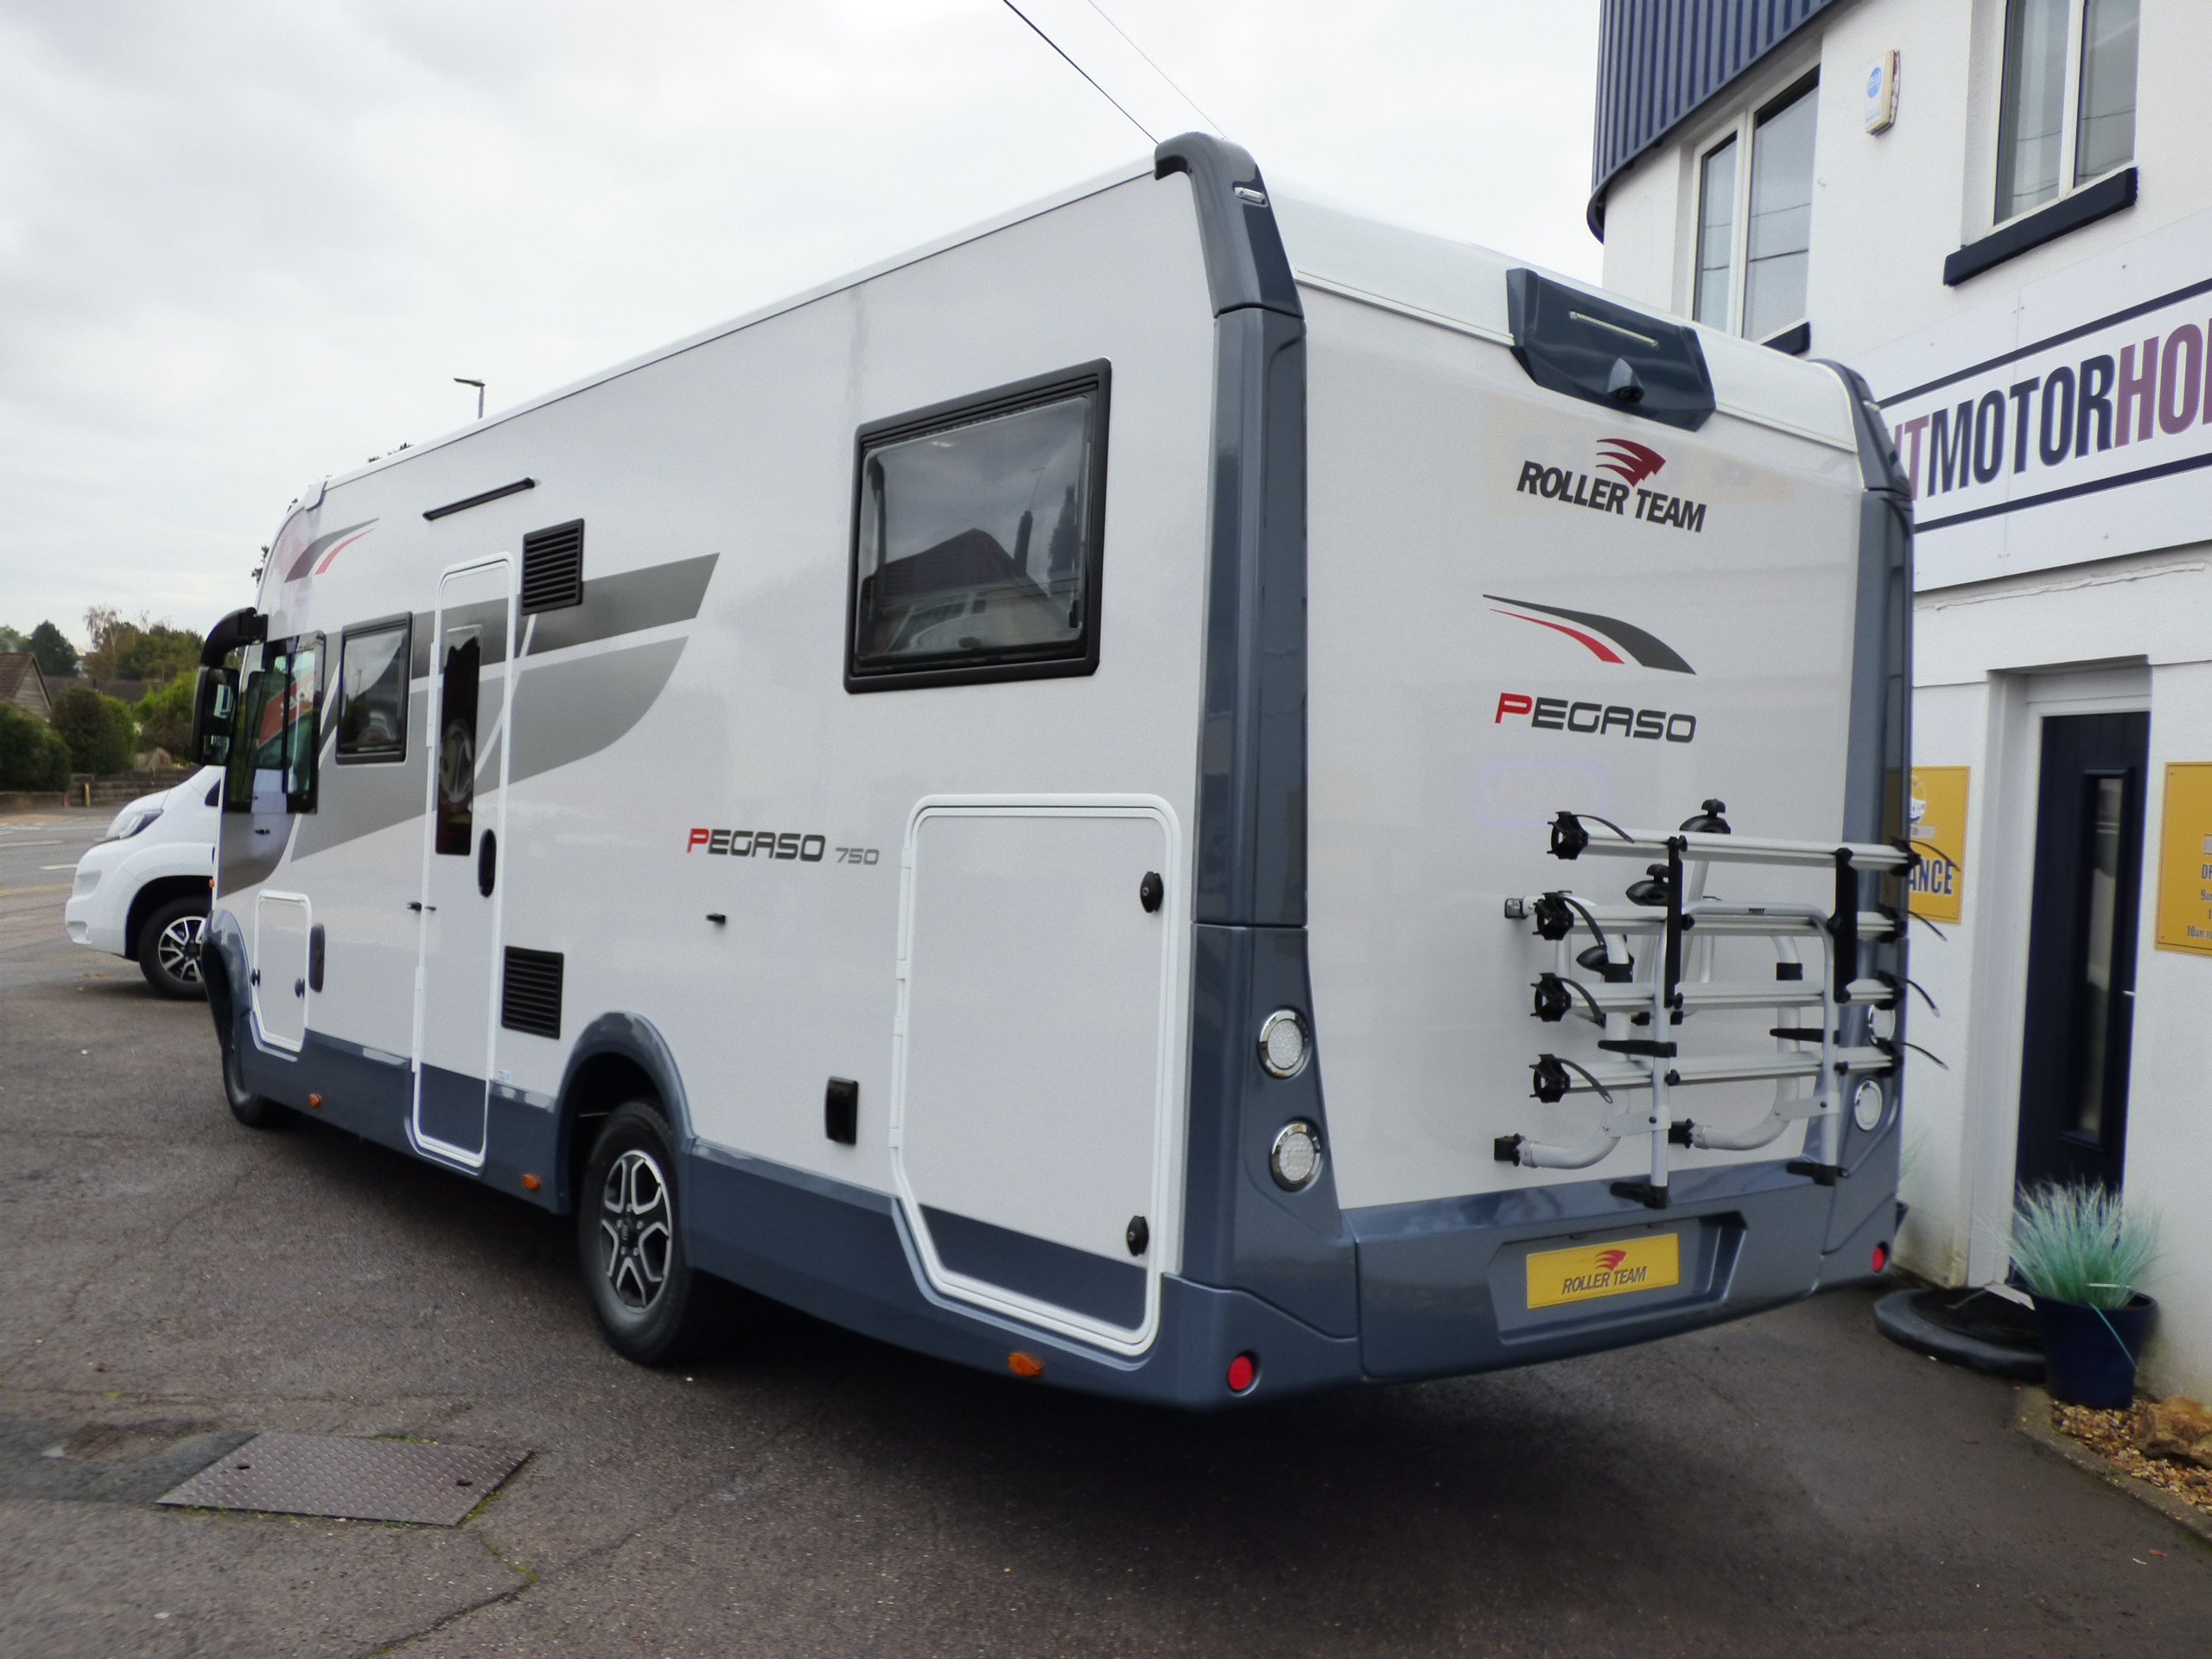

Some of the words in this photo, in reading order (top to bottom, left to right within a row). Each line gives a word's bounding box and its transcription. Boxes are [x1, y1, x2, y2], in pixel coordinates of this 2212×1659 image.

[1516, 460, 1630, 516] ROLLER
[1634, 488, 1707, 533] TEAM
[1494, 692, 1697, 744] PEGASO
[686, 828, 826, 862] PEGASO
[835, 847, 880, 865] 750
[1562, 1273, 1610, 1294] ROLLER
[1613, 1265, 1647, 1286] TEAM
